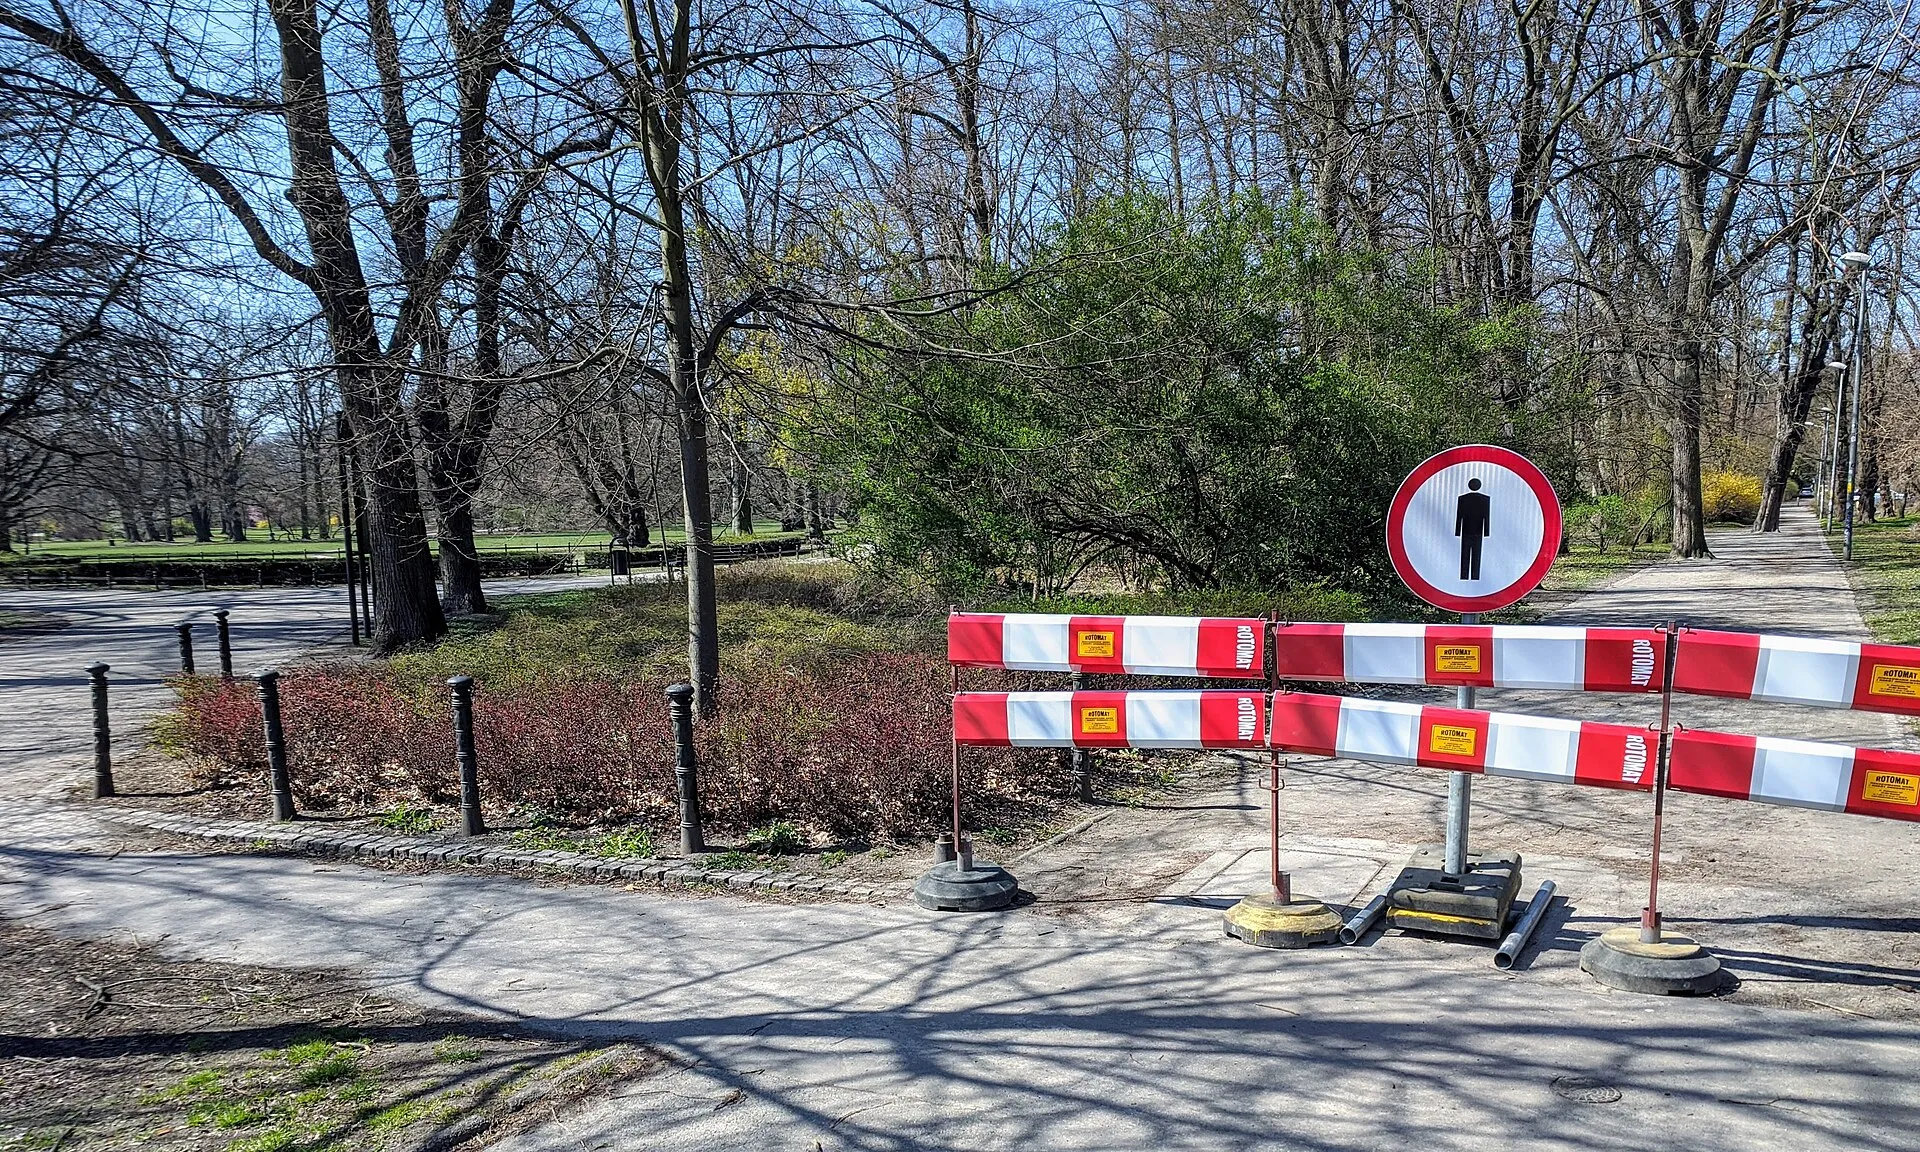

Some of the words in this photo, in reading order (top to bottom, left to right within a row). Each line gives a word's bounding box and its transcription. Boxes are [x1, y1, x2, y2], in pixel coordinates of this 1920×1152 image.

[1236, 625, 1255, 669] ROTOMAT
[1631, 639, 1654, 686] ROTOMAT
[1883, 670, 1918, 679] ROTOMAT
[1238, 697, 1257, 741] ROTOMAT
[1441, 730, 1468, 738] ROTOMAT
[1622, 734, 1647, 784] ROTOMAT
[1875, 775, 1910, 785] ROTOMAT
